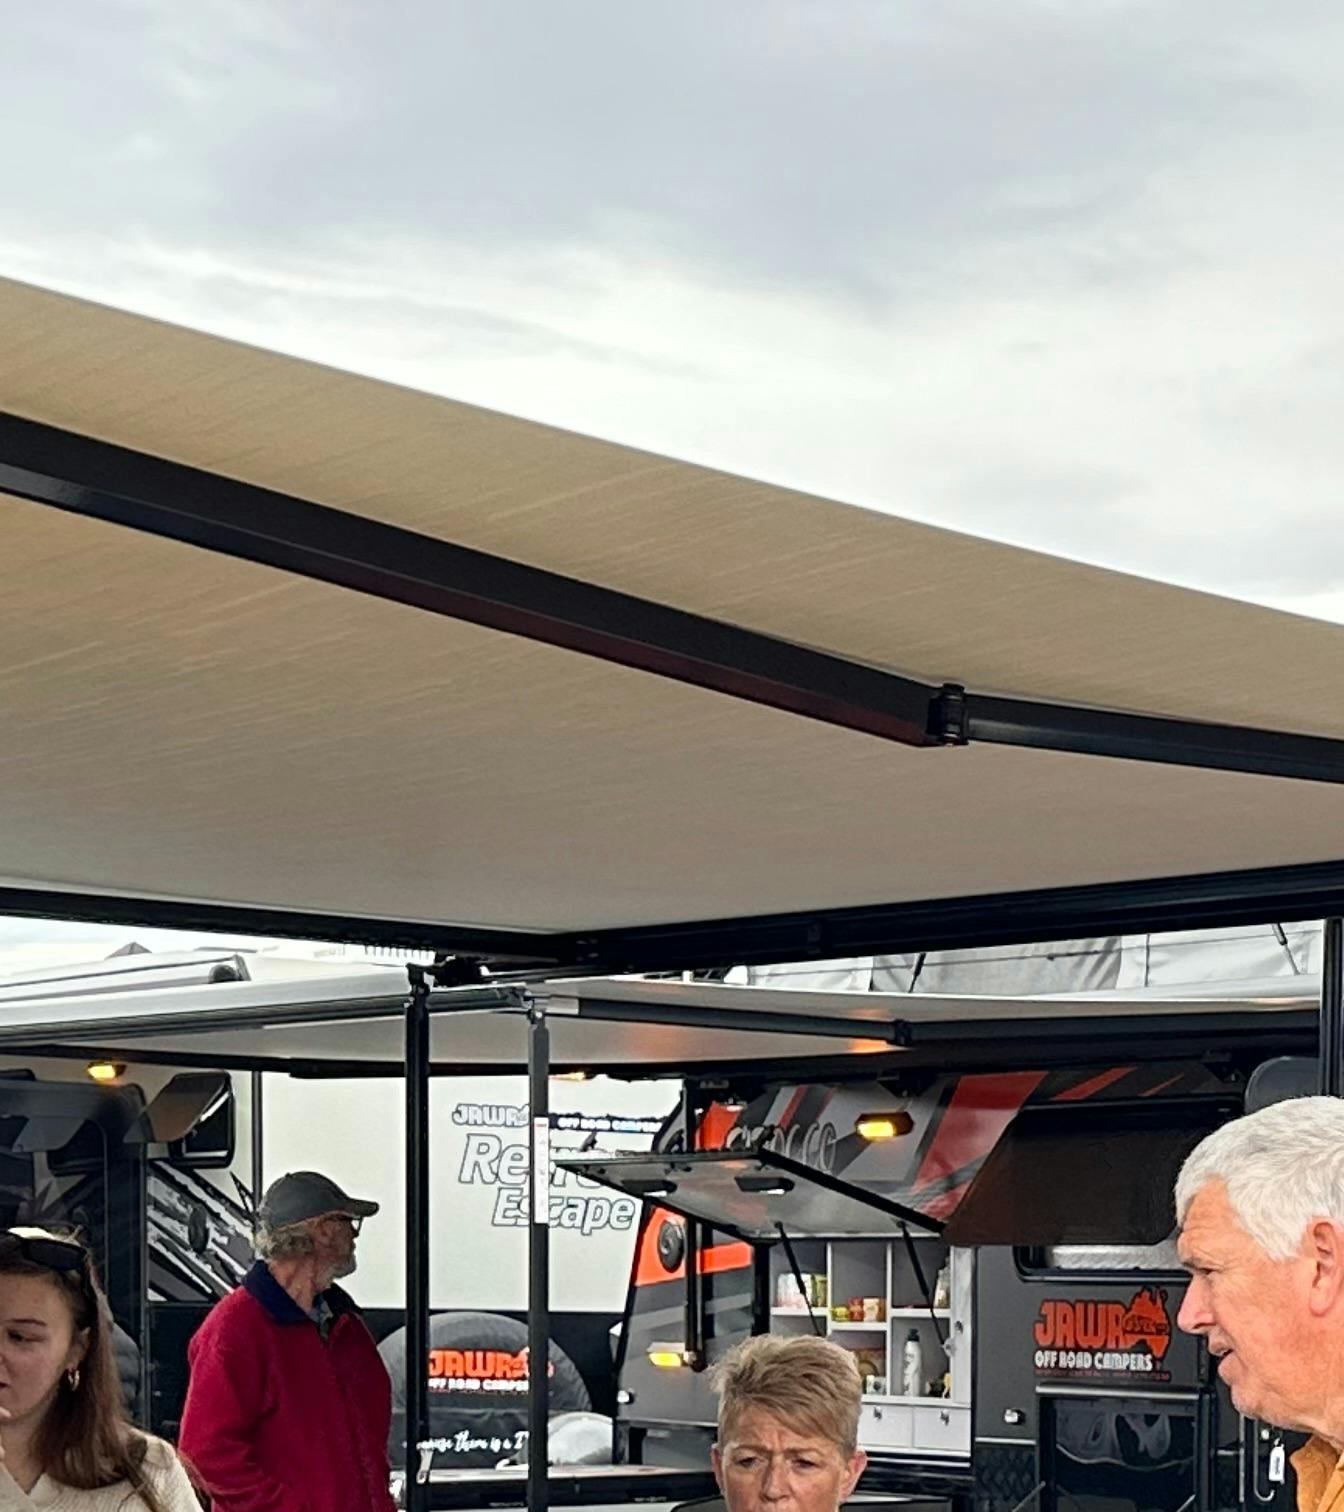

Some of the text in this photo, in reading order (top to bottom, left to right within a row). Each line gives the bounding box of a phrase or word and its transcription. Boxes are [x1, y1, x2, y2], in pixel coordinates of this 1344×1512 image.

[1035, 1350, 1153, 1372] OFF ROAD CAMPERS
